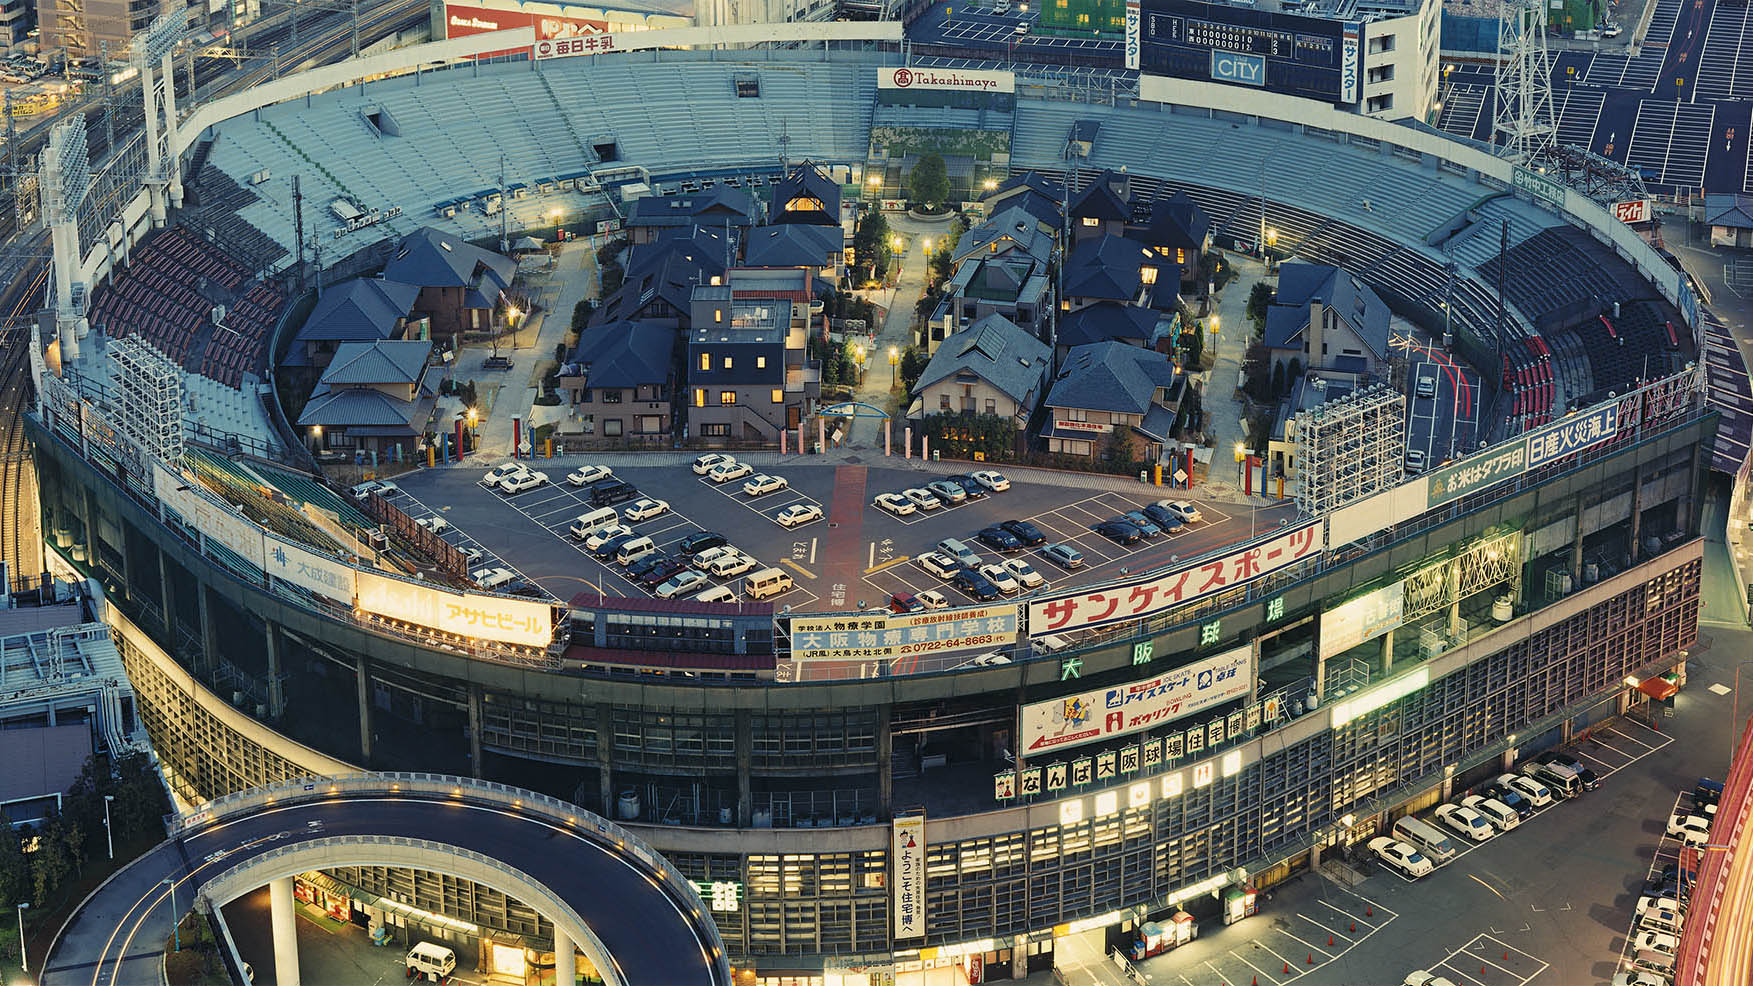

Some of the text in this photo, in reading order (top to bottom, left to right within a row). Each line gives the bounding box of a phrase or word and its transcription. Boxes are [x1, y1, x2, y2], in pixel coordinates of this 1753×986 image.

[556, 36, 614, 55] 毎日牛乳
[1128, 15, 1138, 66] サンスター
[914, 72, 997, 90] Takashimaya
[1218, 59, 1259, 80] CITY
[1344, 46, 1356, 99] サンスター
[1530, 410, 1615, 463] 日産火災海上
[1448, 447, 1524, 492] お米はタワラ印
[1043, 527, 1313, 630] サンケイスポーツ
[445, 604, 542, 634] アサヒビール
[803, 616, 1005, 648] 大阪物療専門学校
[1125, 677, 1190, 704] アイススケート
[1216, 668, 1237, 682] 卓球
[1129, 703, 1180, 727] ボウリング
[901, 850, 913, 932] ようこそ住宅博へ
